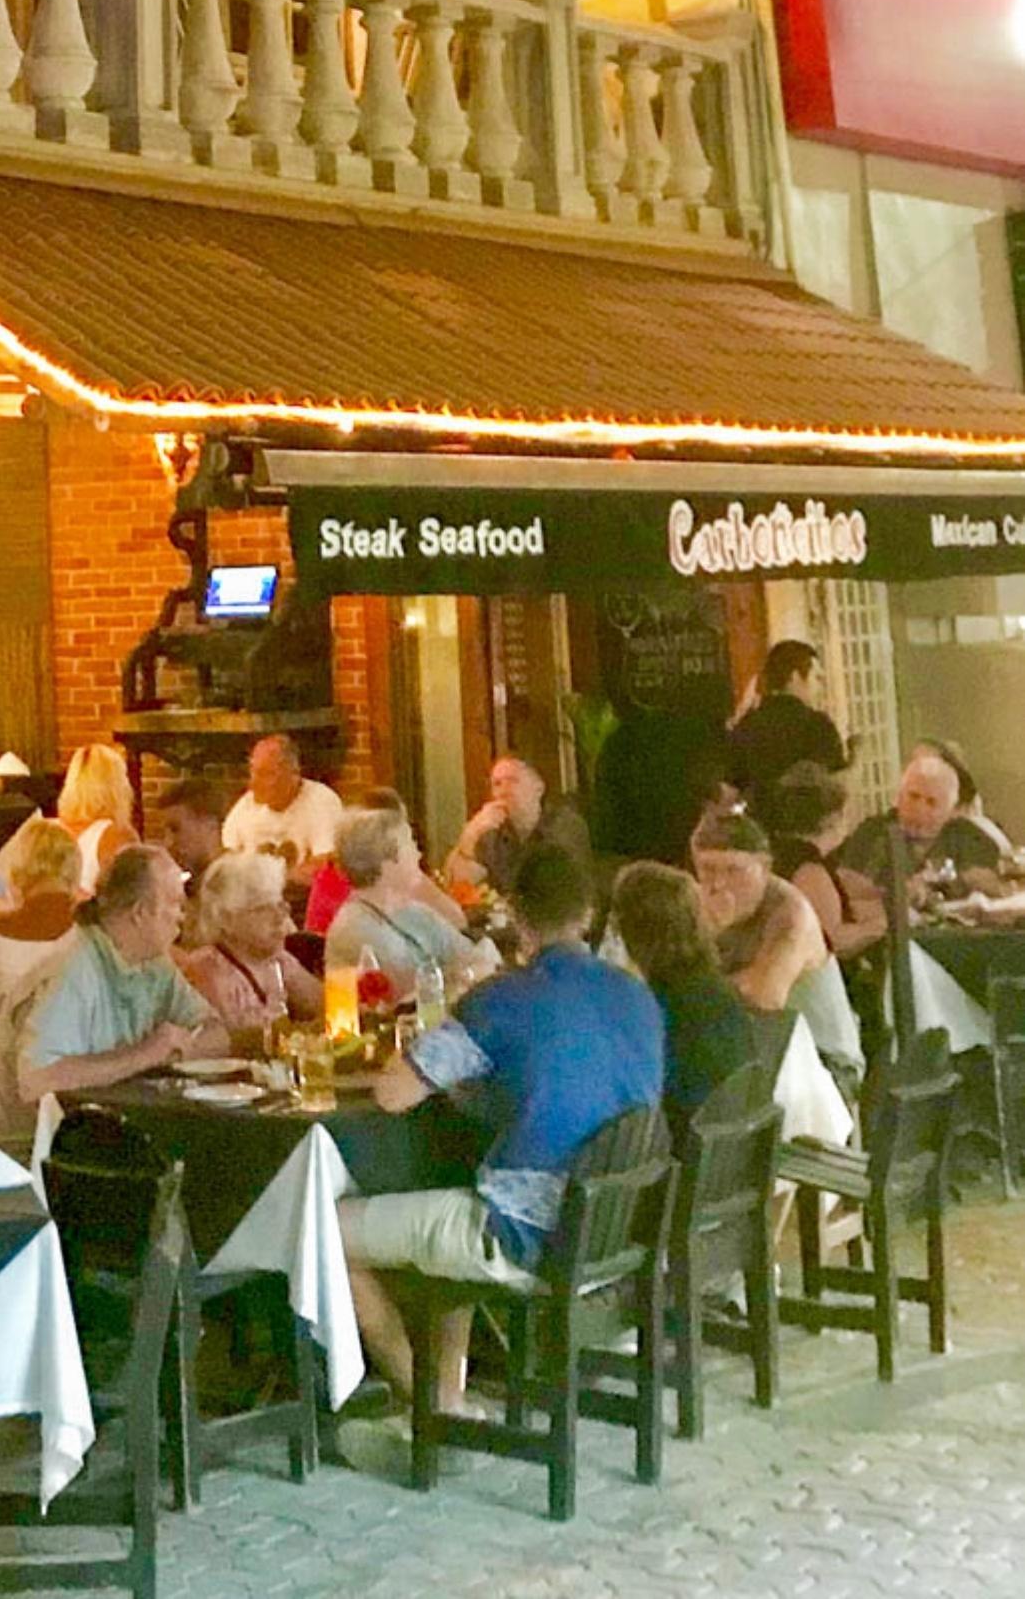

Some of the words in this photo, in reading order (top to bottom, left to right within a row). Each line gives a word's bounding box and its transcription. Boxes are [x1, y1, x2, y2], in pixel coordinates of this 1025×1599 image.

[319, 517, 408, 558] Steak
[417, 516, 545, 558] Seafood
[930, 513, 997, 548] Mexican
